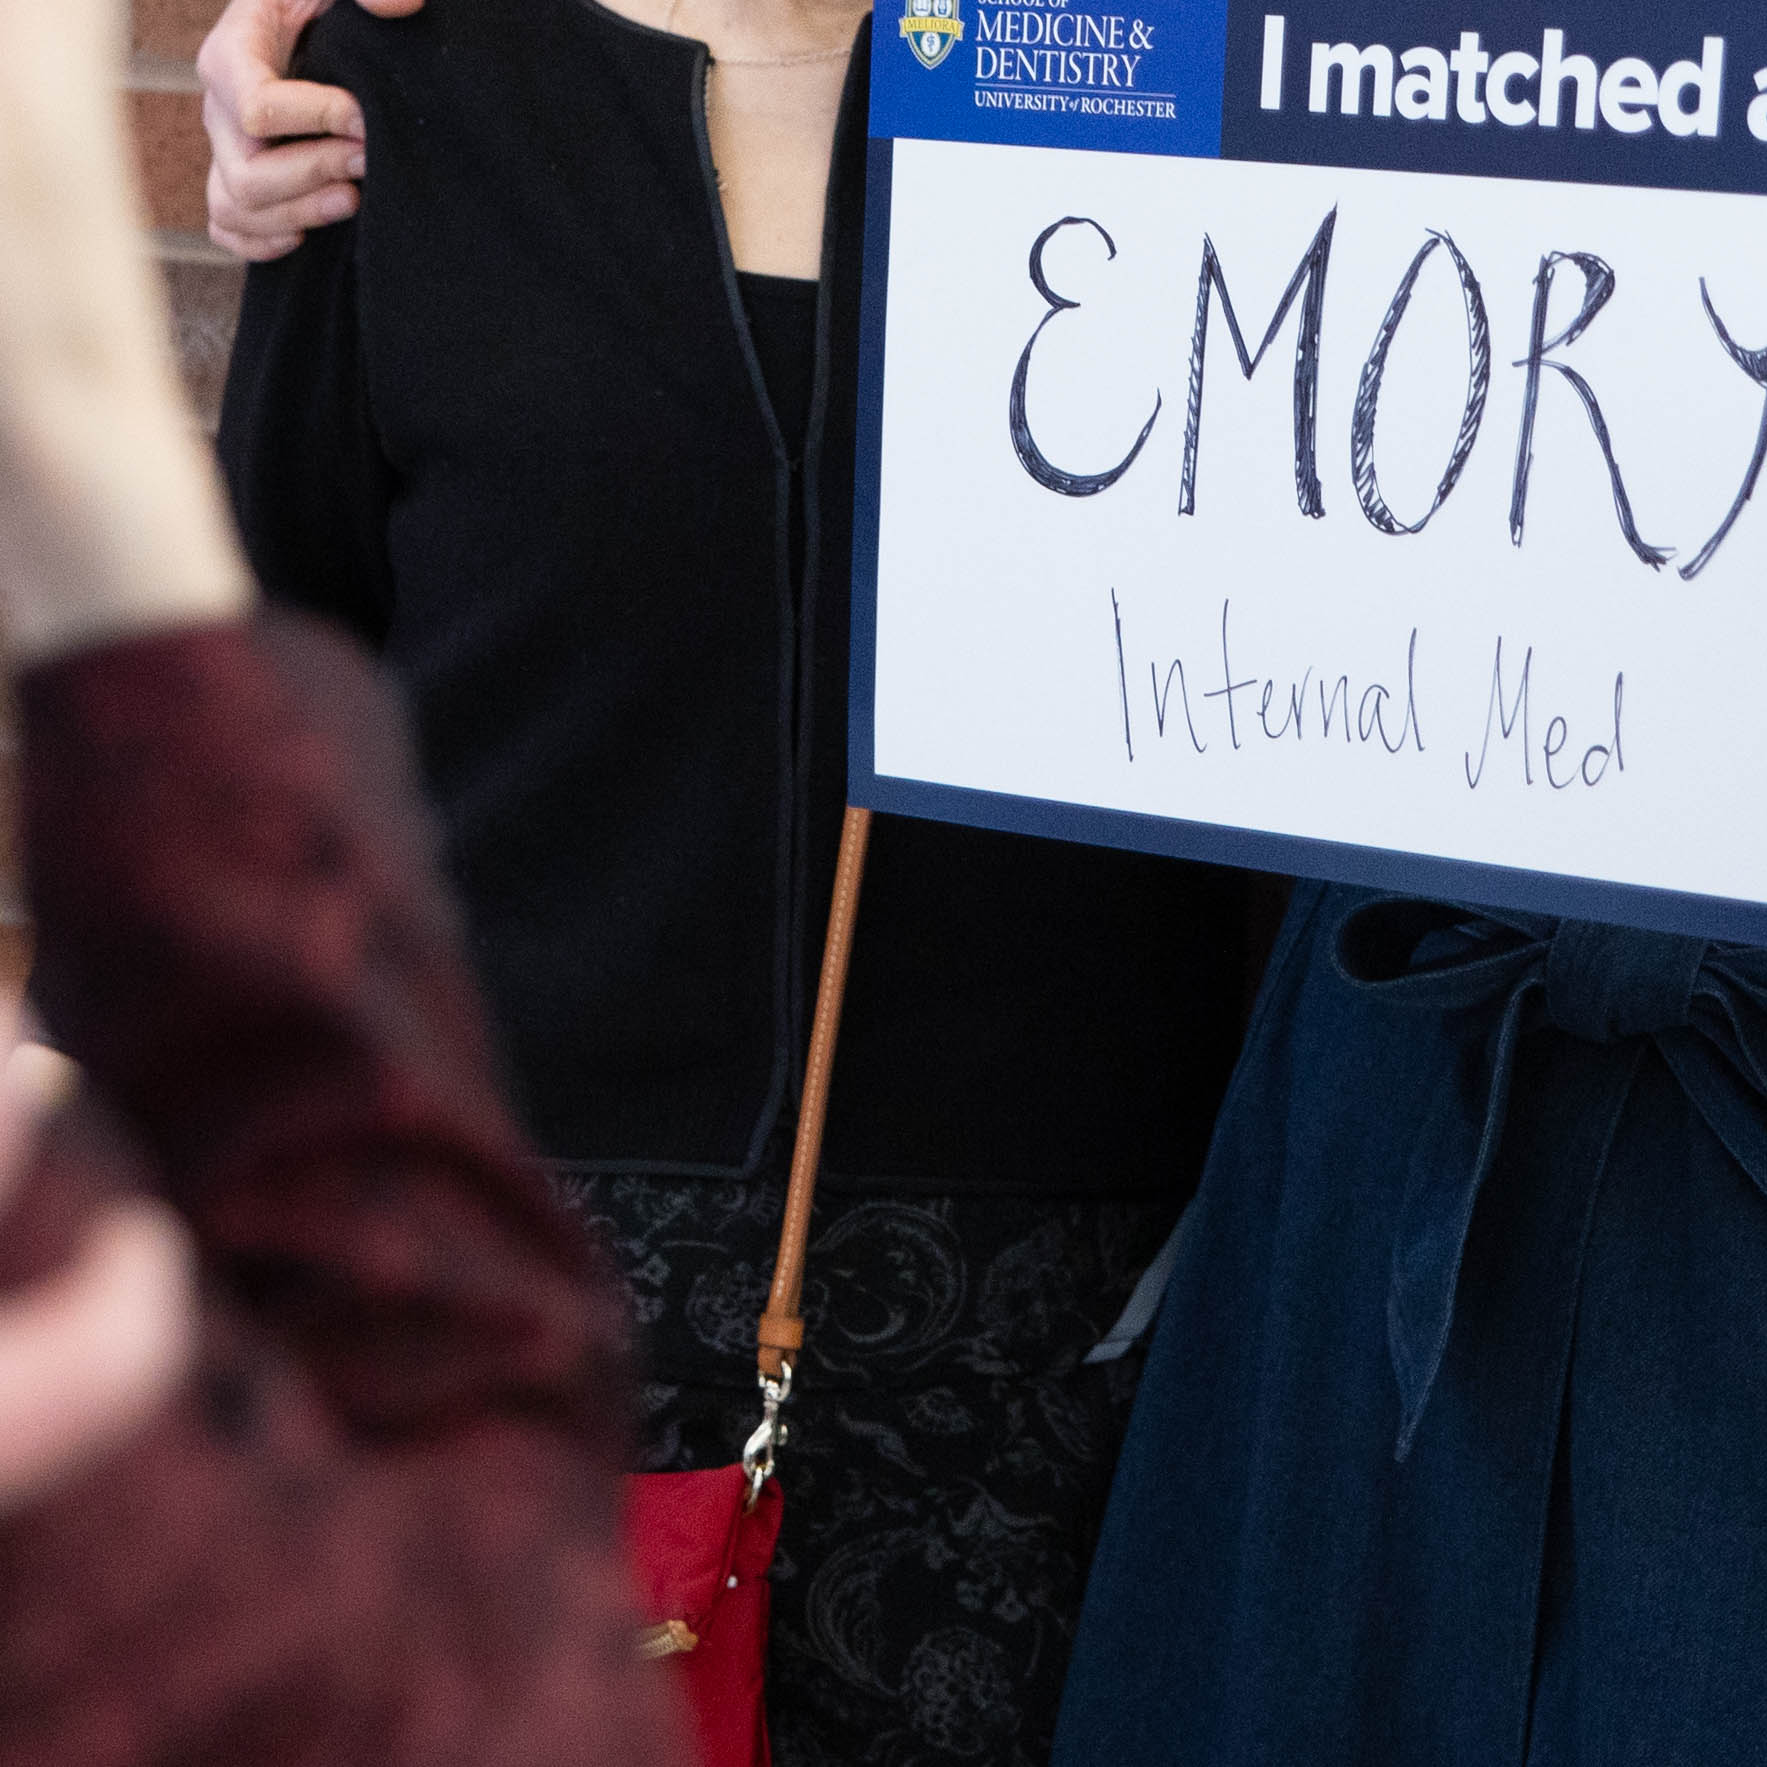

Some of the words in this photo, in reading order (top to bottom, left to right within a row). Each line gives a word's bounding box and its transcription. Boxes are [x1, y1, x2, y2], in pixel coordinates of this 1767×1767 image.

[976, 9, 1125, 49] MEDICINE
[1129, 18, 1153, 49] &
[975, 46, 1140, 86] DENTISTRY
[1260, 14, 1285, 111] I
[1308, 28, 1725, 138] matched
[974, 90, 1069, 112] UNIVERSITY
[1069, 97, 1080, 112] of
[1081, 97, 1176, 119] ROCHESTER
[1112, 587, 1426, 762] Internal
[1465, 635, 1626, 790] Med
